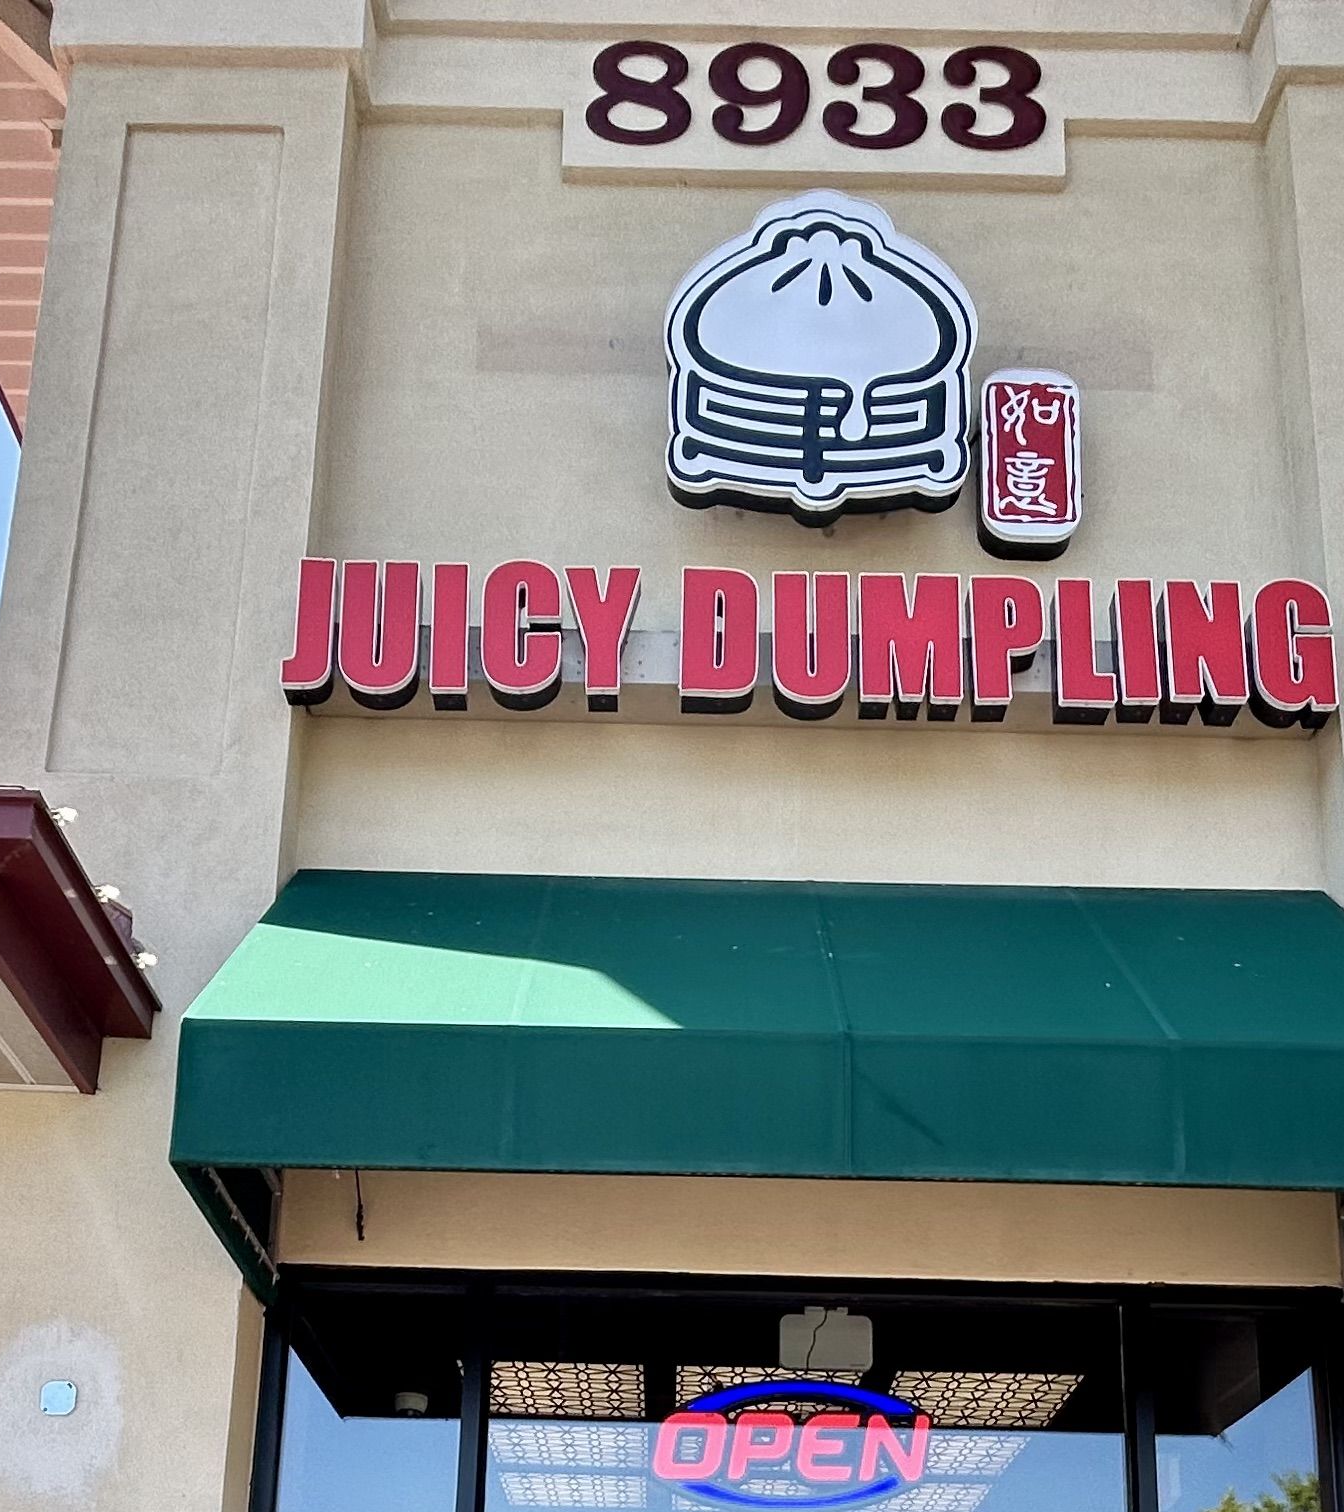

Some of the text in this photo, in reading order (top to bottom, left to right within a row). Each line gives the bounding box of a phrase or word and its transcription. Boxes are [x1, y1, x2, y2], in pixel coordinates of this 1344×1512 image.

[584, 39, 1047, 151] 8933
[999, 384, 1074, 517] 如意
[280, 558, 1340, 715] JUICY DUMPLING
[653, 1411, 932, 1482] OPEN
